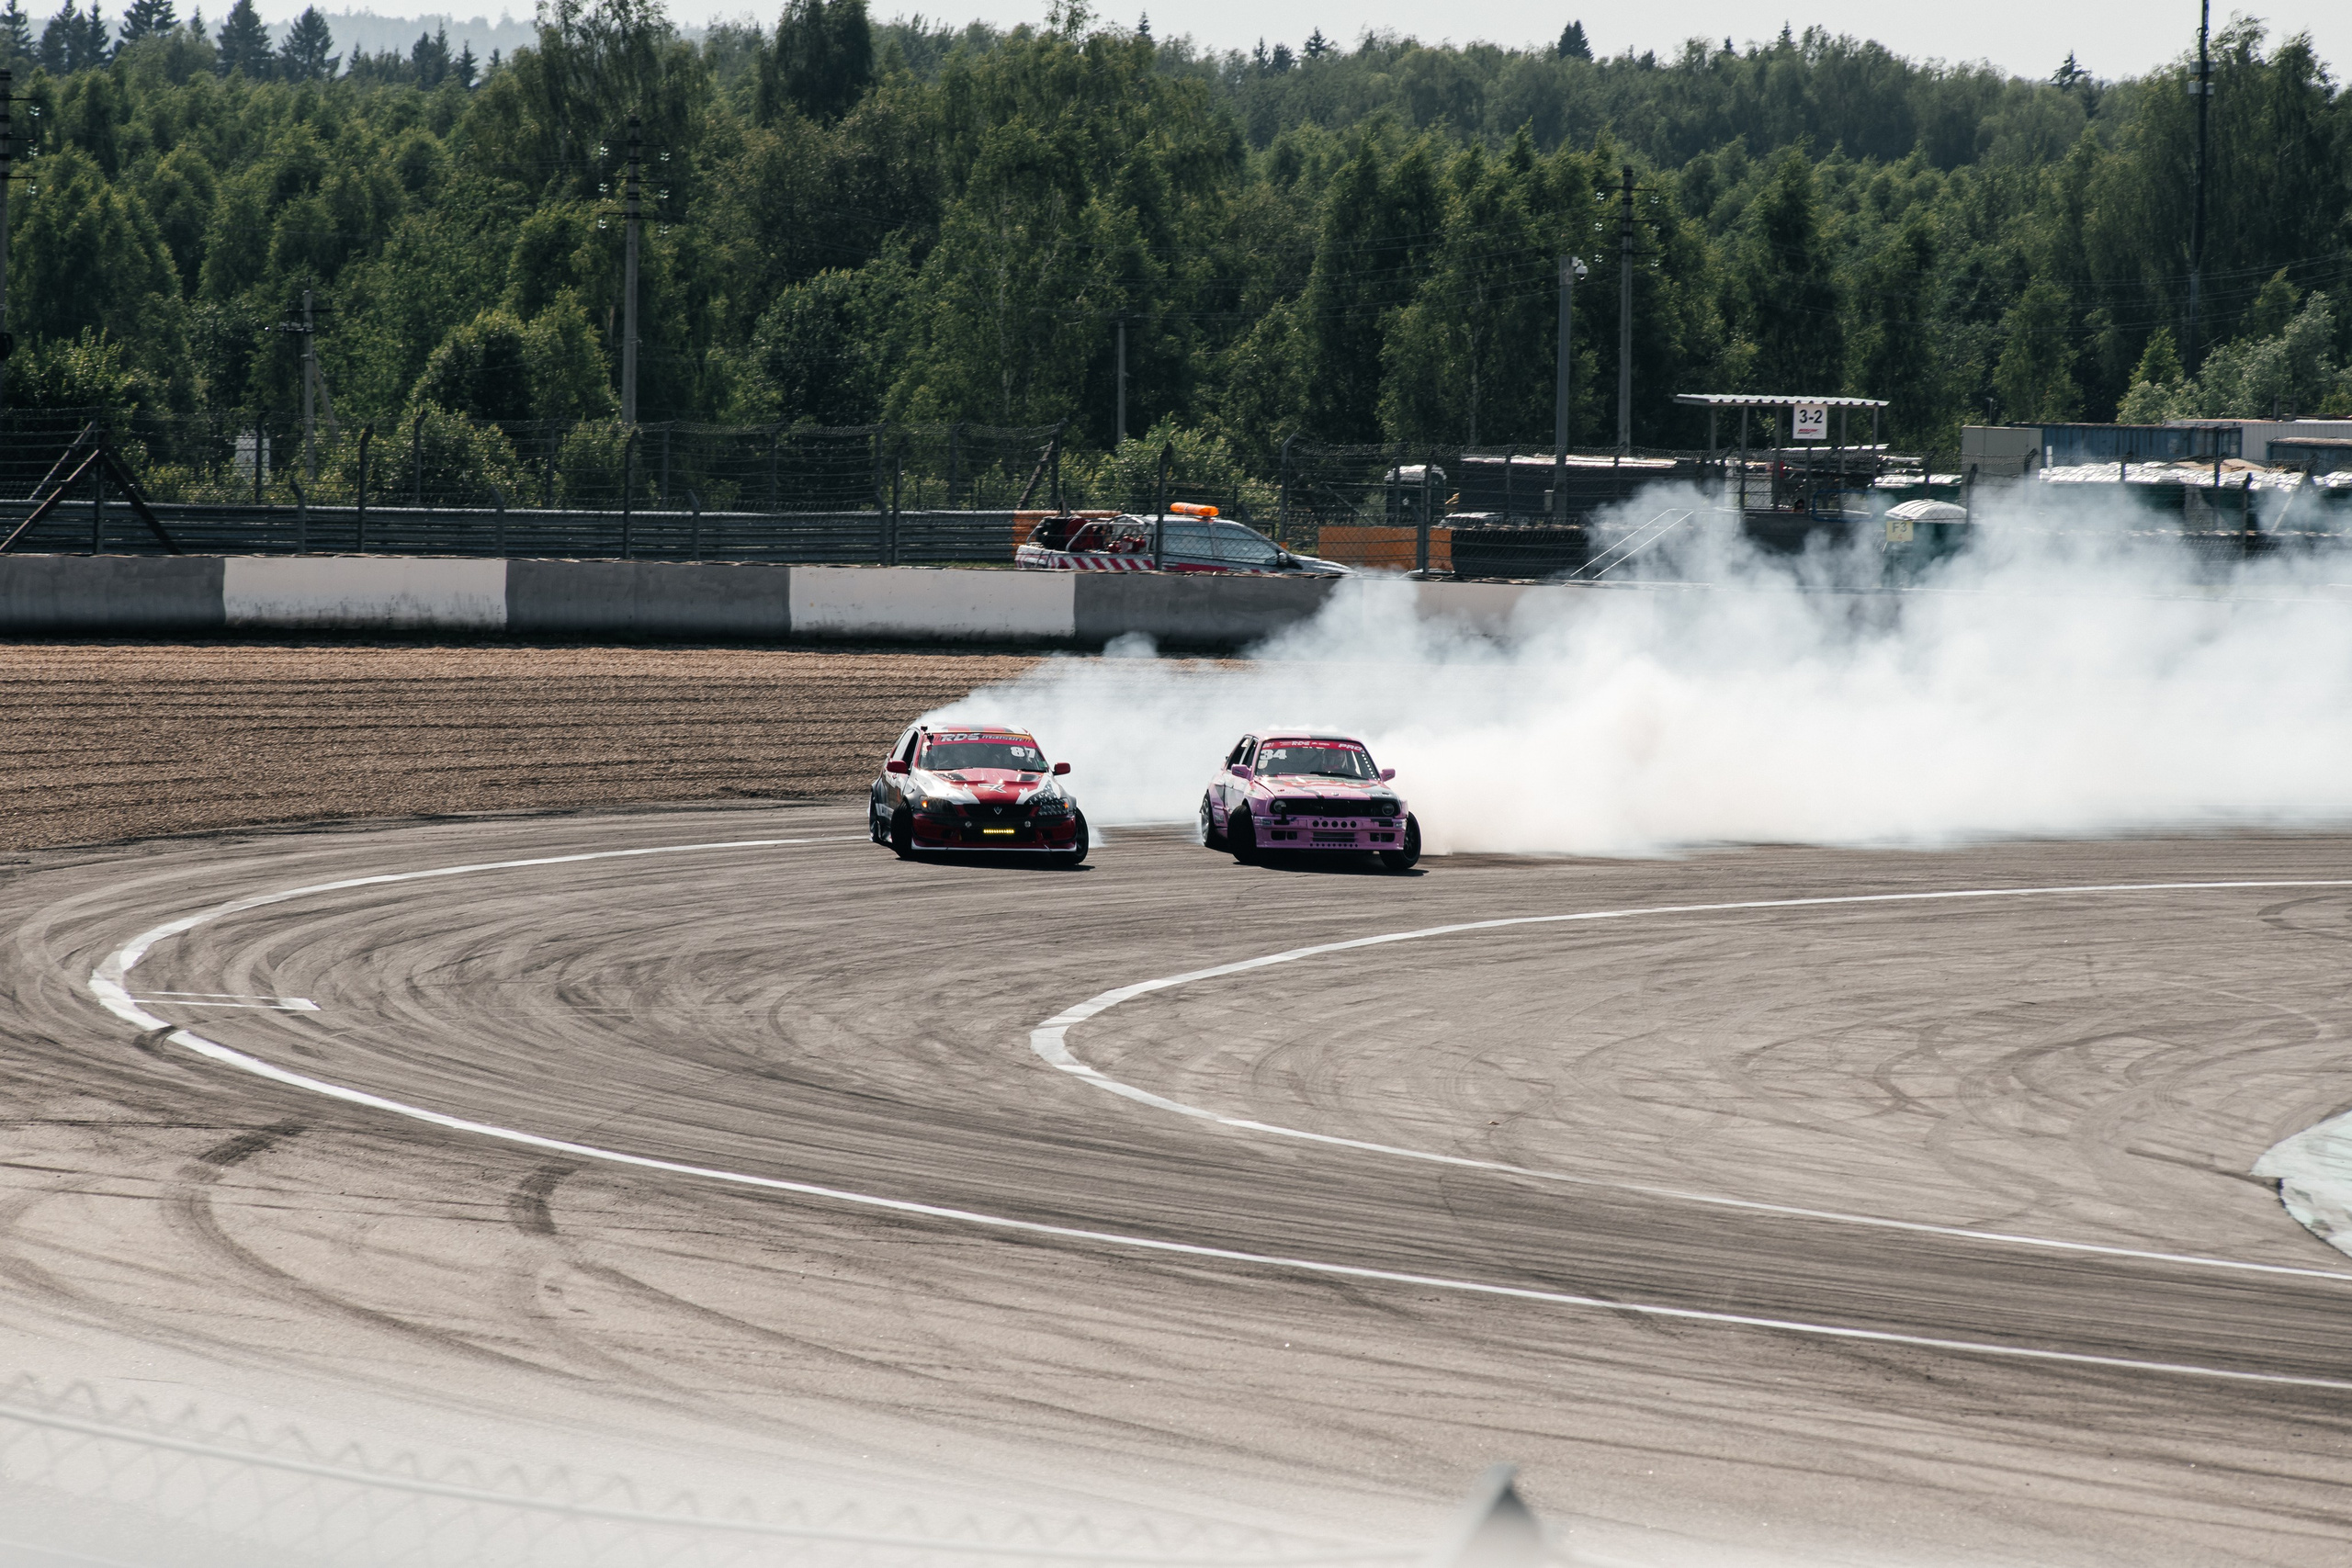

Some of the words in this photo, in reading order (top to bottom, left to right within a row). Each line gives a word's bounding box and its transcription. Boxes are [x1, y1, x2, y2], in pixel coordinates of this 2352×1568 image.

[1799, 409, 1823, 423] 3-2
[1892, 522, 1907, 533] F3
[1011, 746, 1035, 759] 87
[1338, 743, 1362, 751] PRO
[1260, 749, 1287, 761] 34
